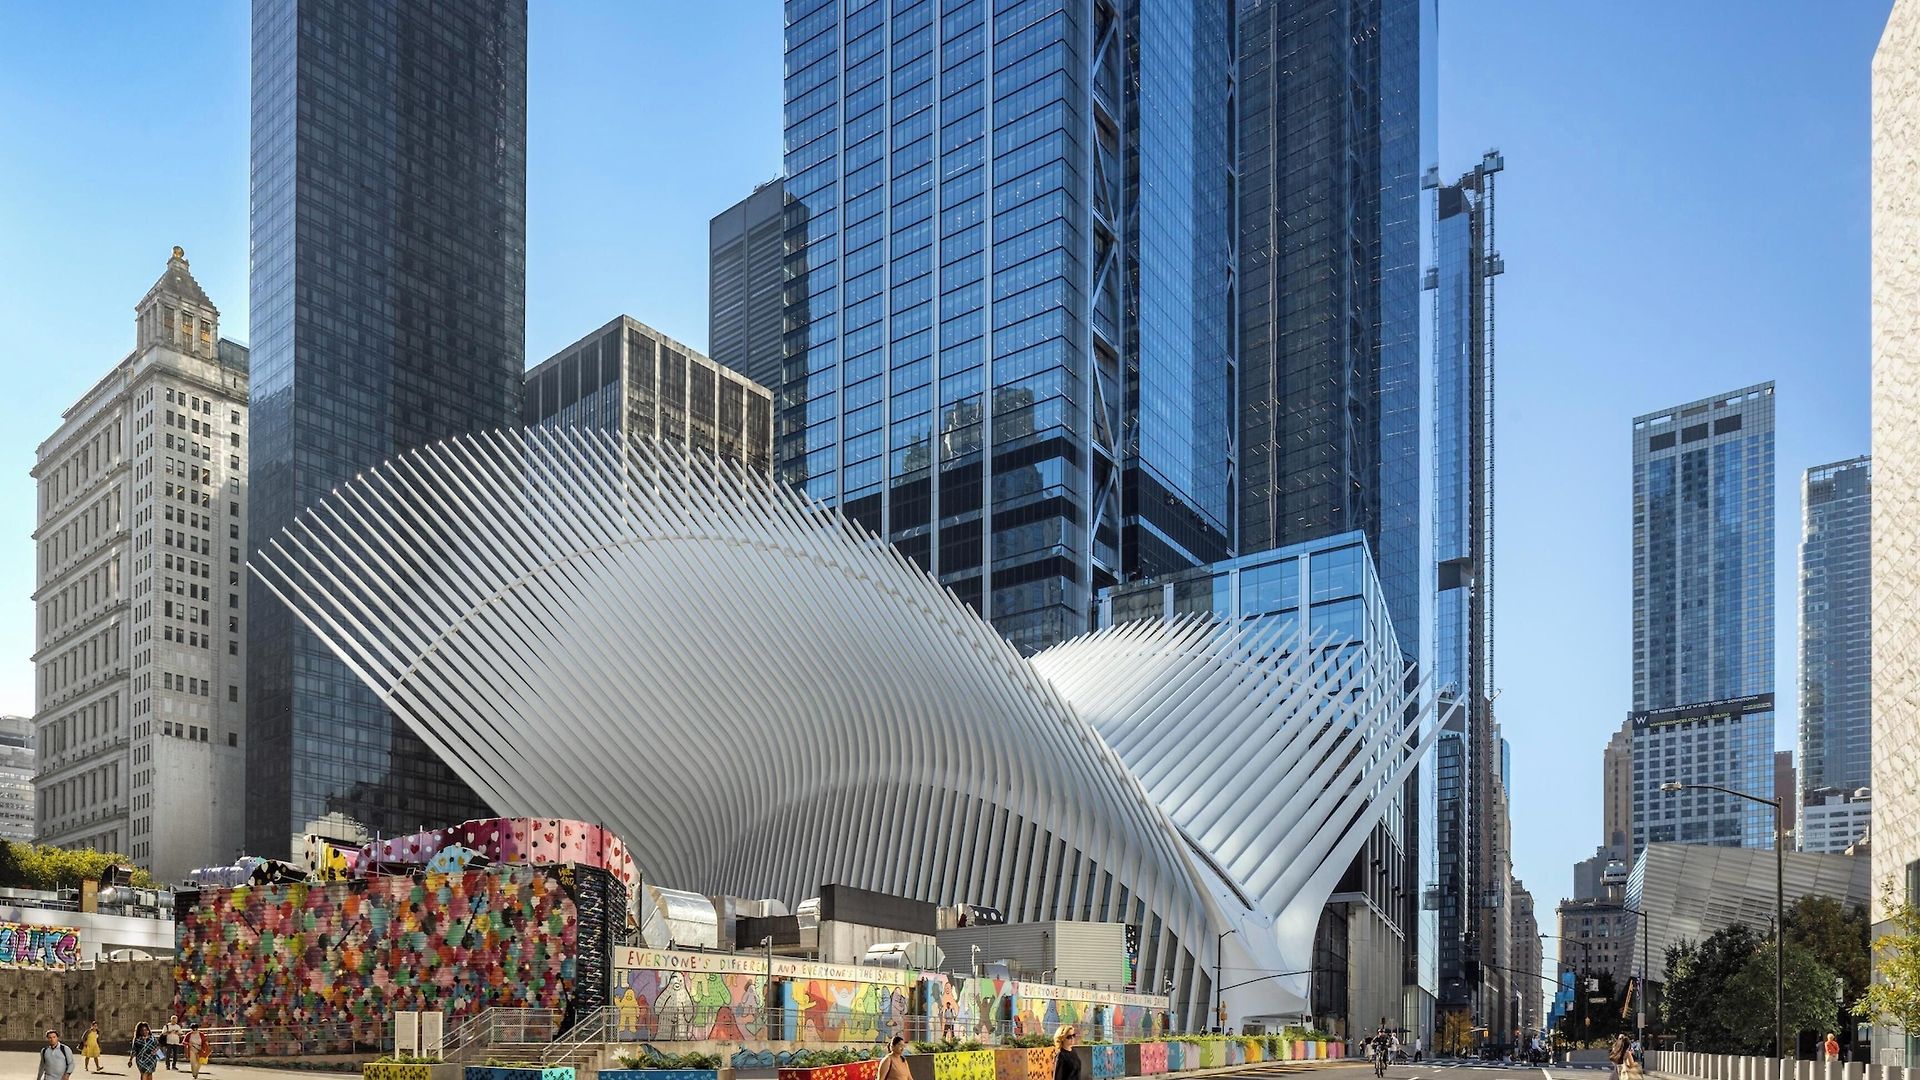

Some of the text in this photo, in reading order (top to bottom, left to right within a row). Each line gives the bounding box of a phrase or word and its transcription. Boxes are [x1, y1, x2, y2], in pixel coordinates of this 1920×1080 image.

[1635, 715, 1648, 725] W
[627, 950, 710, 969] EVERYONE'S
[719, 958, 770, 973] DIFFEREN
[777, 964, 796, 974] AND
[802, 964, 853, 978] EVERYONE'S
[859, 970, 872, 979] THE
